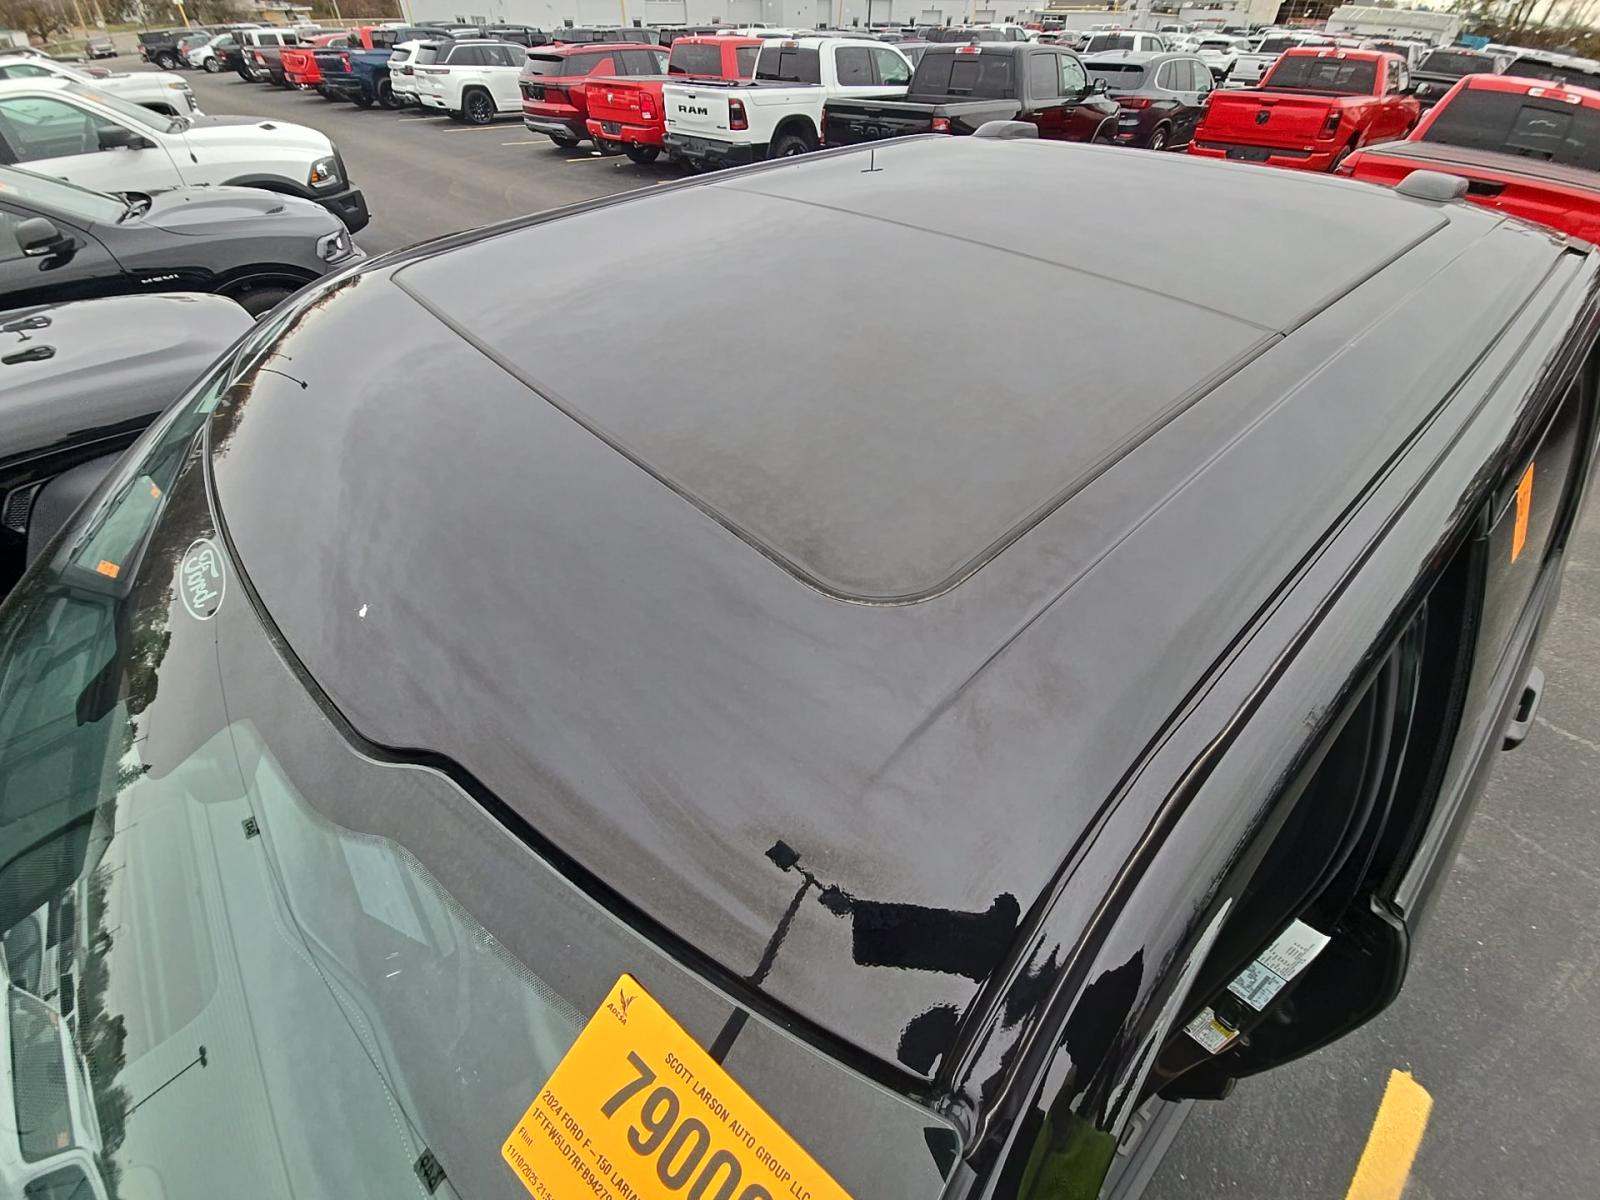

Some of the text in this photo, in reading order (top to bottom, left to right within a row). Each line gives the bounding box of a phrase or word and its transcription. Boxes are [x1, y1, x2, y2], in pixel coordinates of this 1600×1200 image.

[678, 104, 708, 115] RAM
[184, 549, 219, 608] Ford
[518, 1126, 534, 1147] Flint
[542, 1090, 563, 1116] 2024
[560, 1112, 584, 1142] FORD
[610, 1172, 642, 1200] LARIA
[600, 1050, 775, 1200] 7900
[665, 1053, 694, 1085] SCOTT
[692, 1080, 730, 1123] LARSON
[728, 1119, 756, 1150] AUTO
[755, 1145, 791, 1182] GROUP
[506, 1144, 555, 1200] 11/10/2025 21:5
